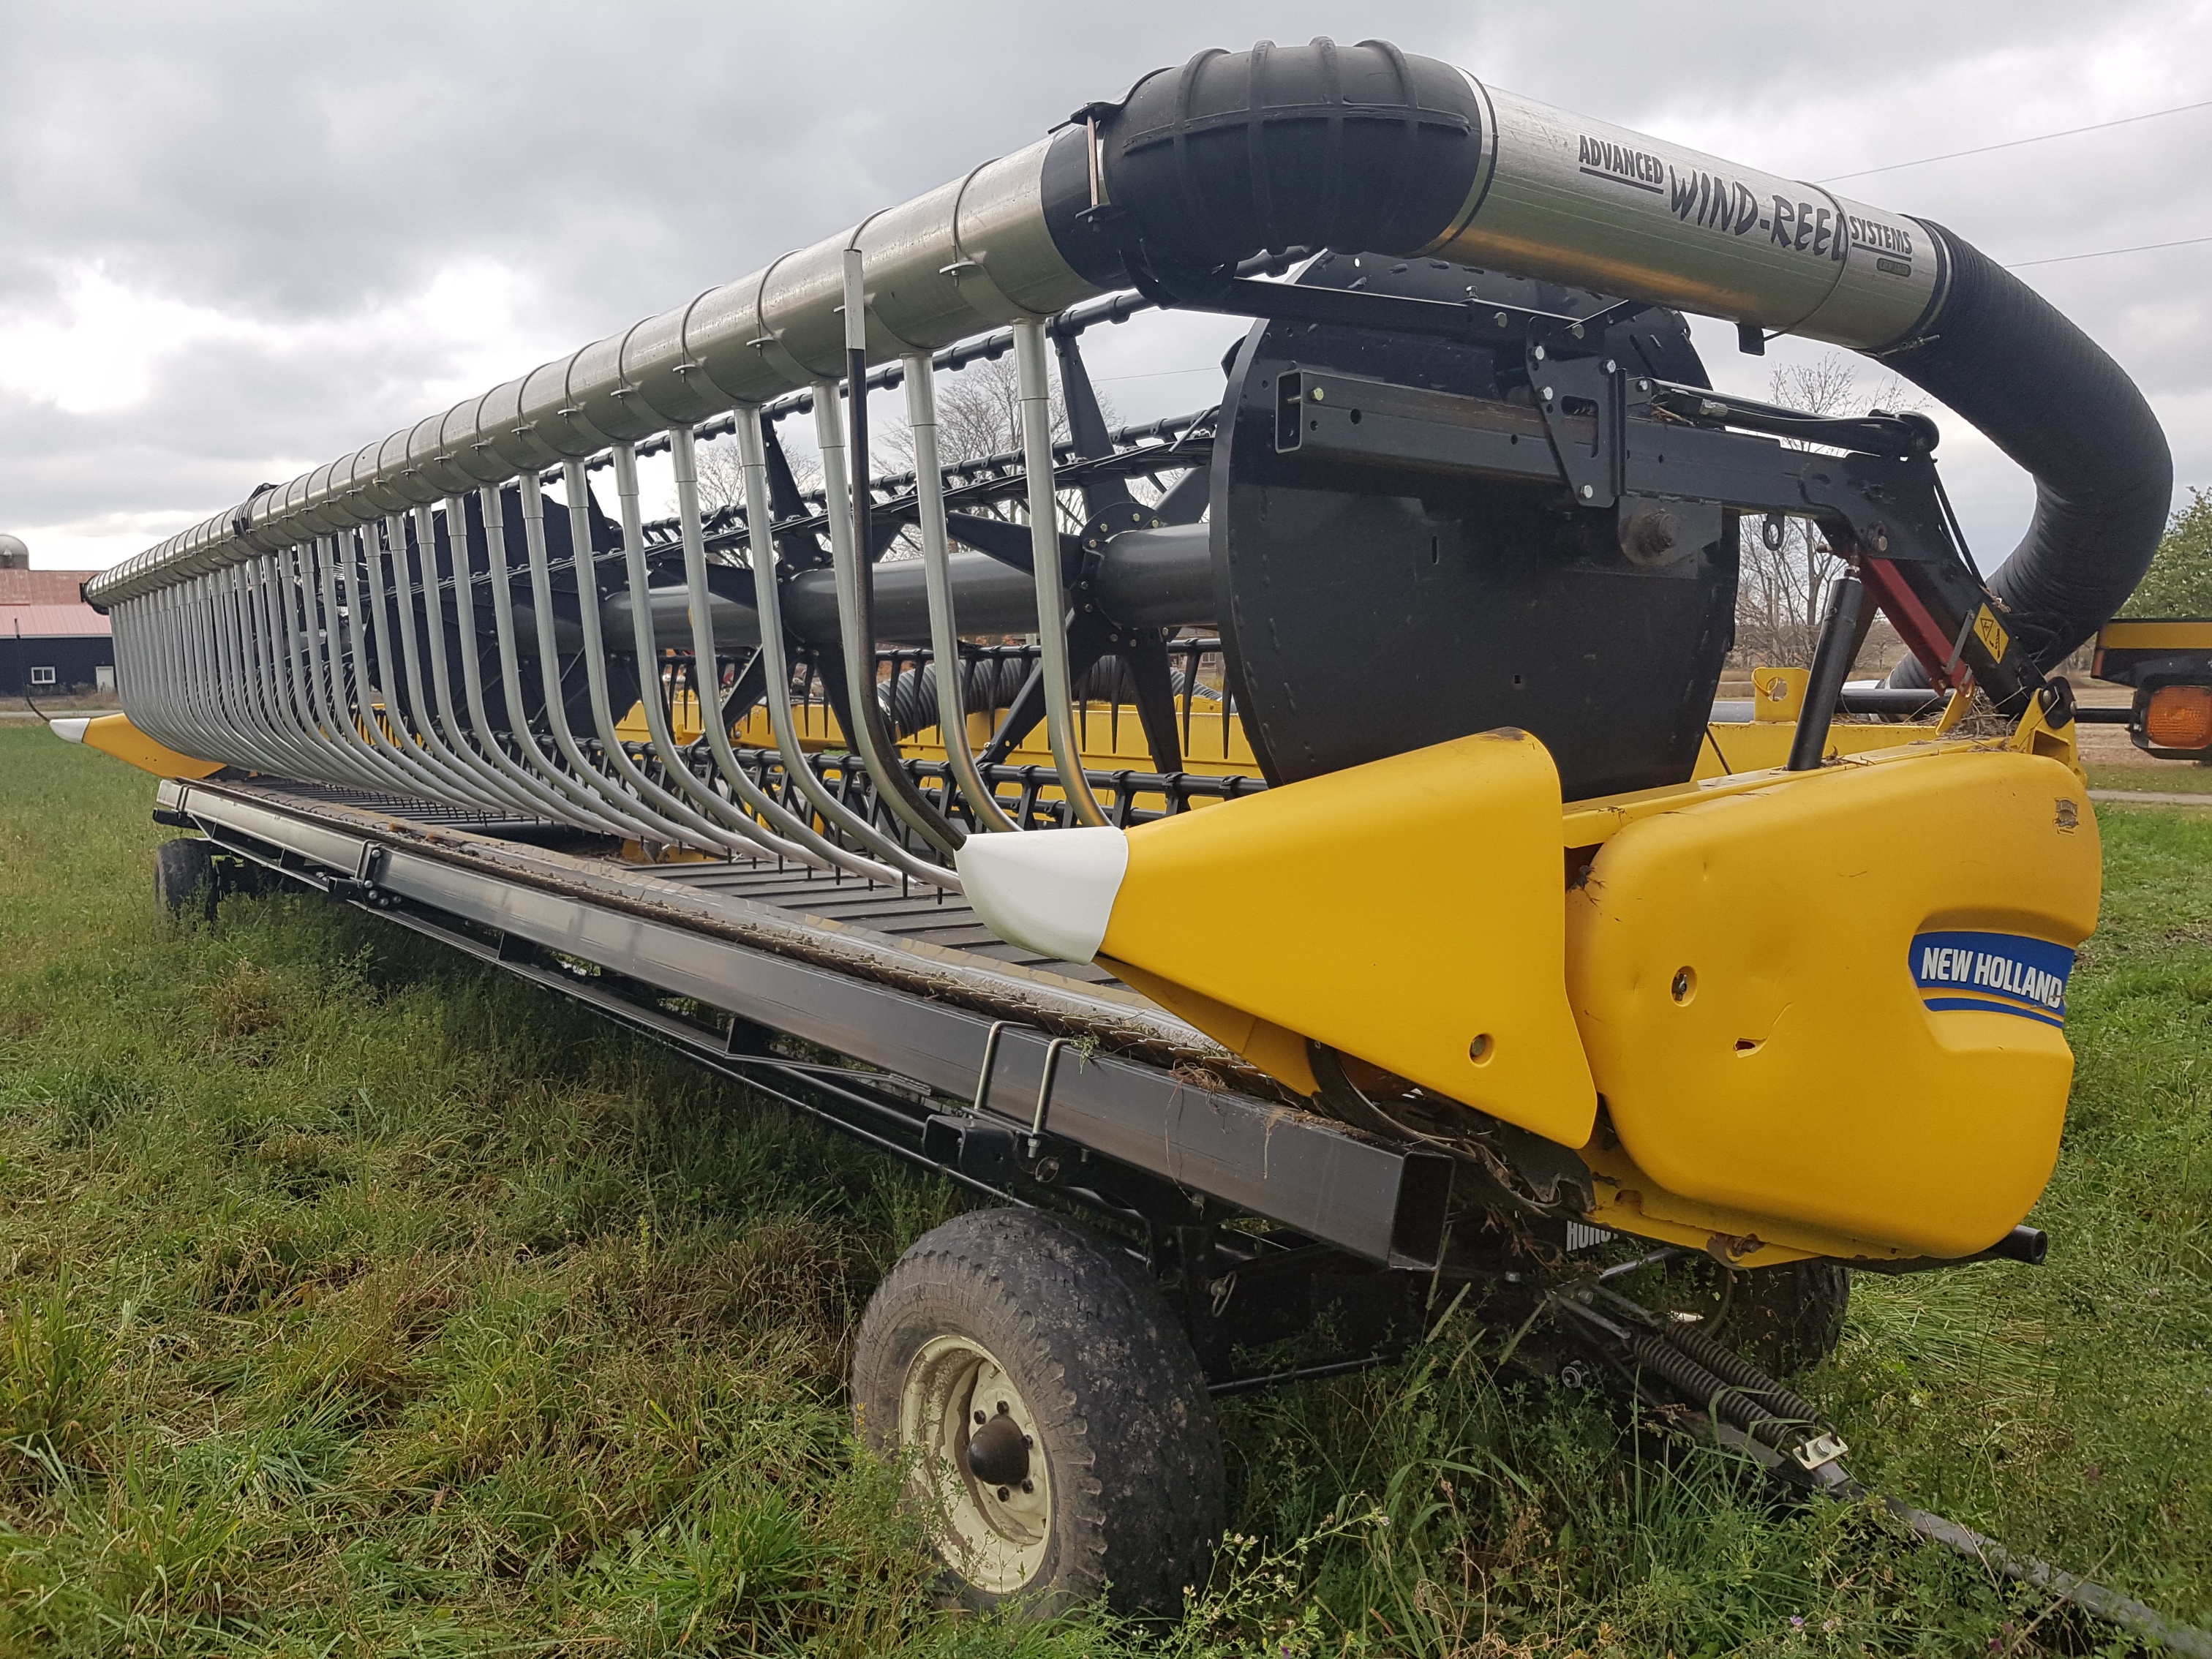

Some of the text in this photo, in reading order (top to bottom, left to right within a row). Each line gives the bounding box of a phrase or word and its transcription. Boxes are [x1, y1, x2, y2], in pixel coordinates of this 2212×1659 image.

[1578, 134, 1913, 262] ADVANCED WIND-REEL SYSTEMS
[1921, 947, 2063, 1009] NEW HOLLAND
